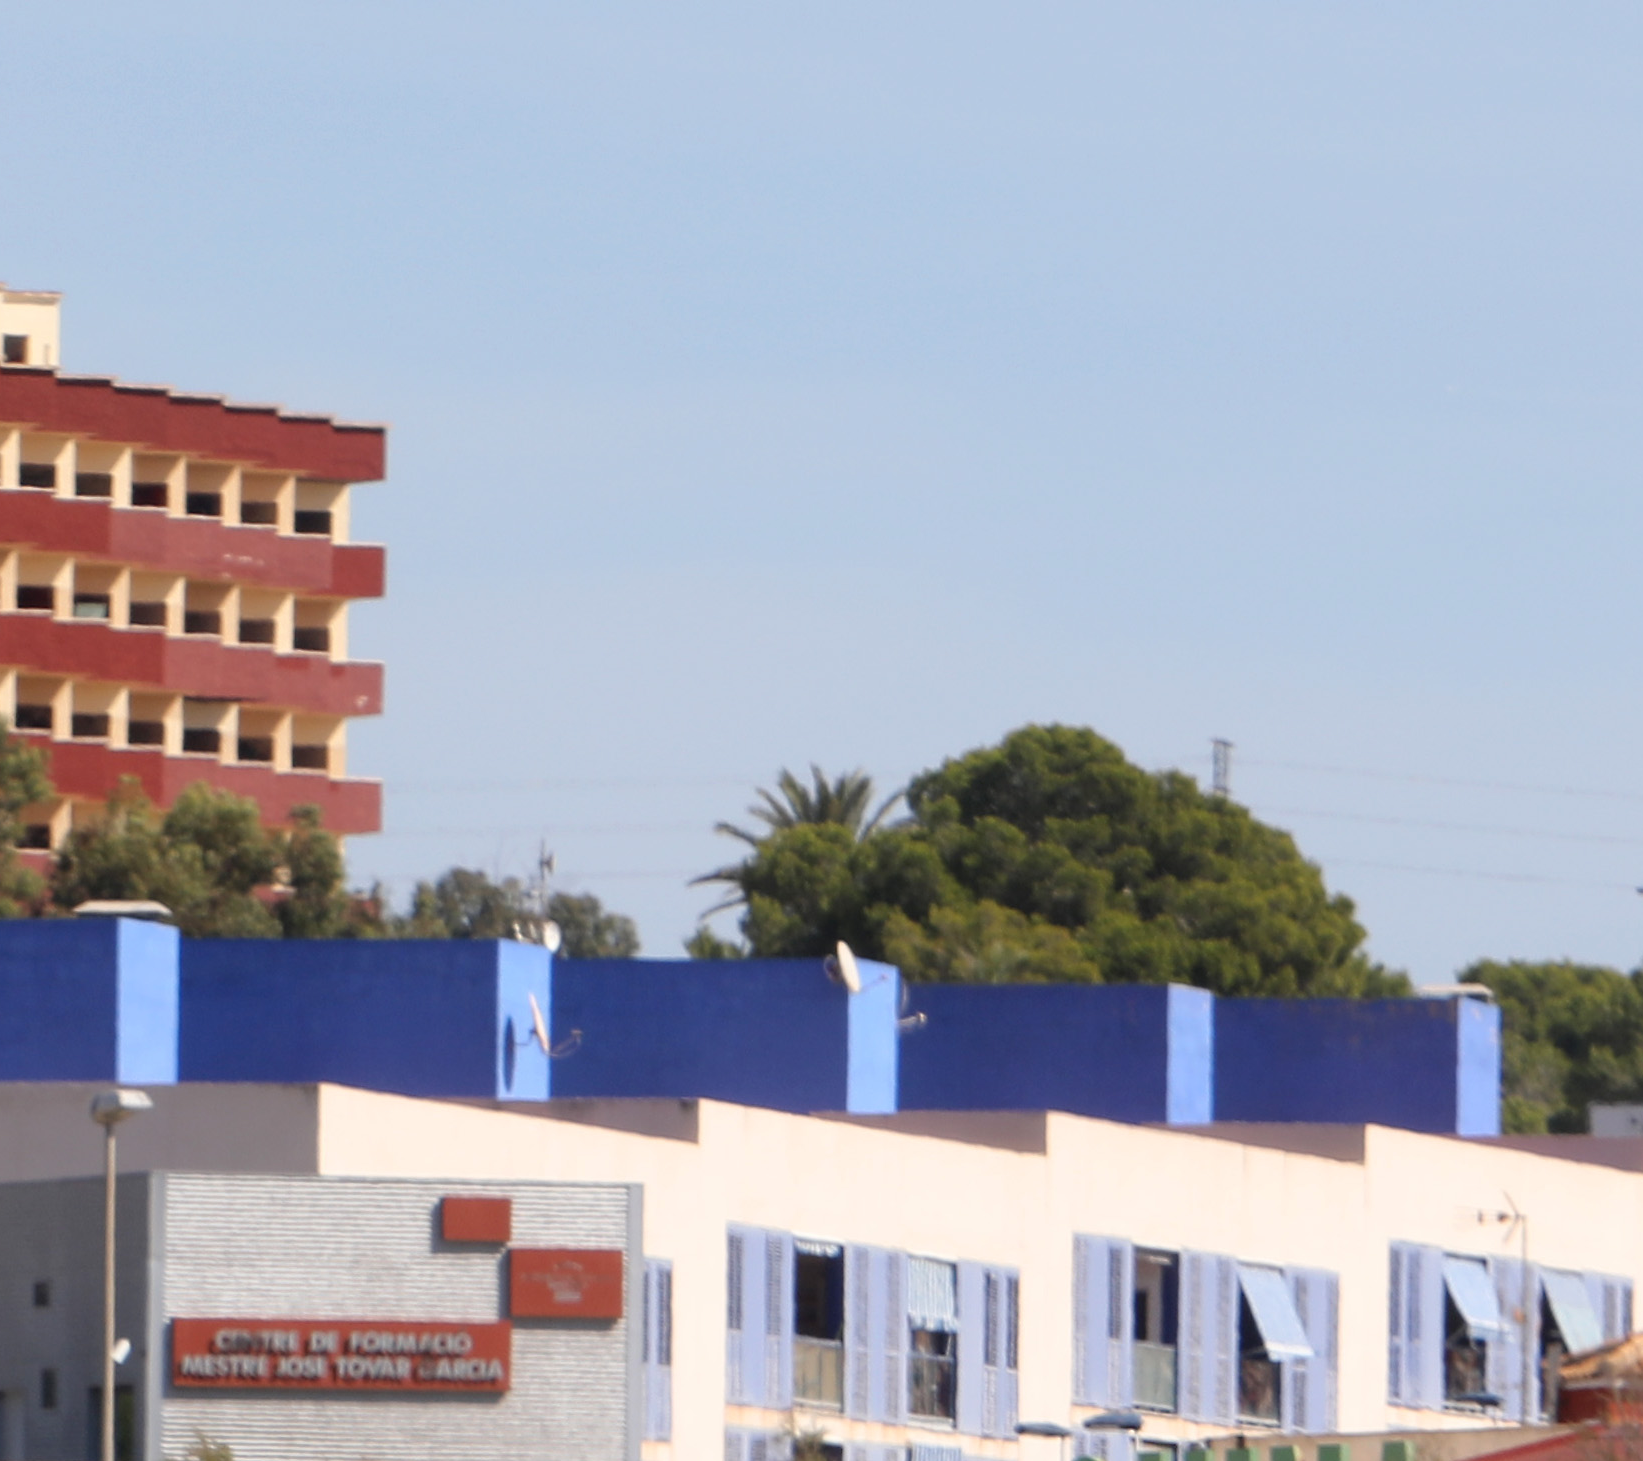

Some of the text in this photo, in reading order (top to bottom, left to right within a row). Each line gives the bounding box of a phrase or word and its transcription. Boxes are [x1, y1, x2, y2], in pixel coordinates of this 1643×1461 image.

[311, 1331, 338, 1353] DE
[181, 1354, 267, 1377] MESTRE
[336, 1356, 411, 1379] TOVAR
